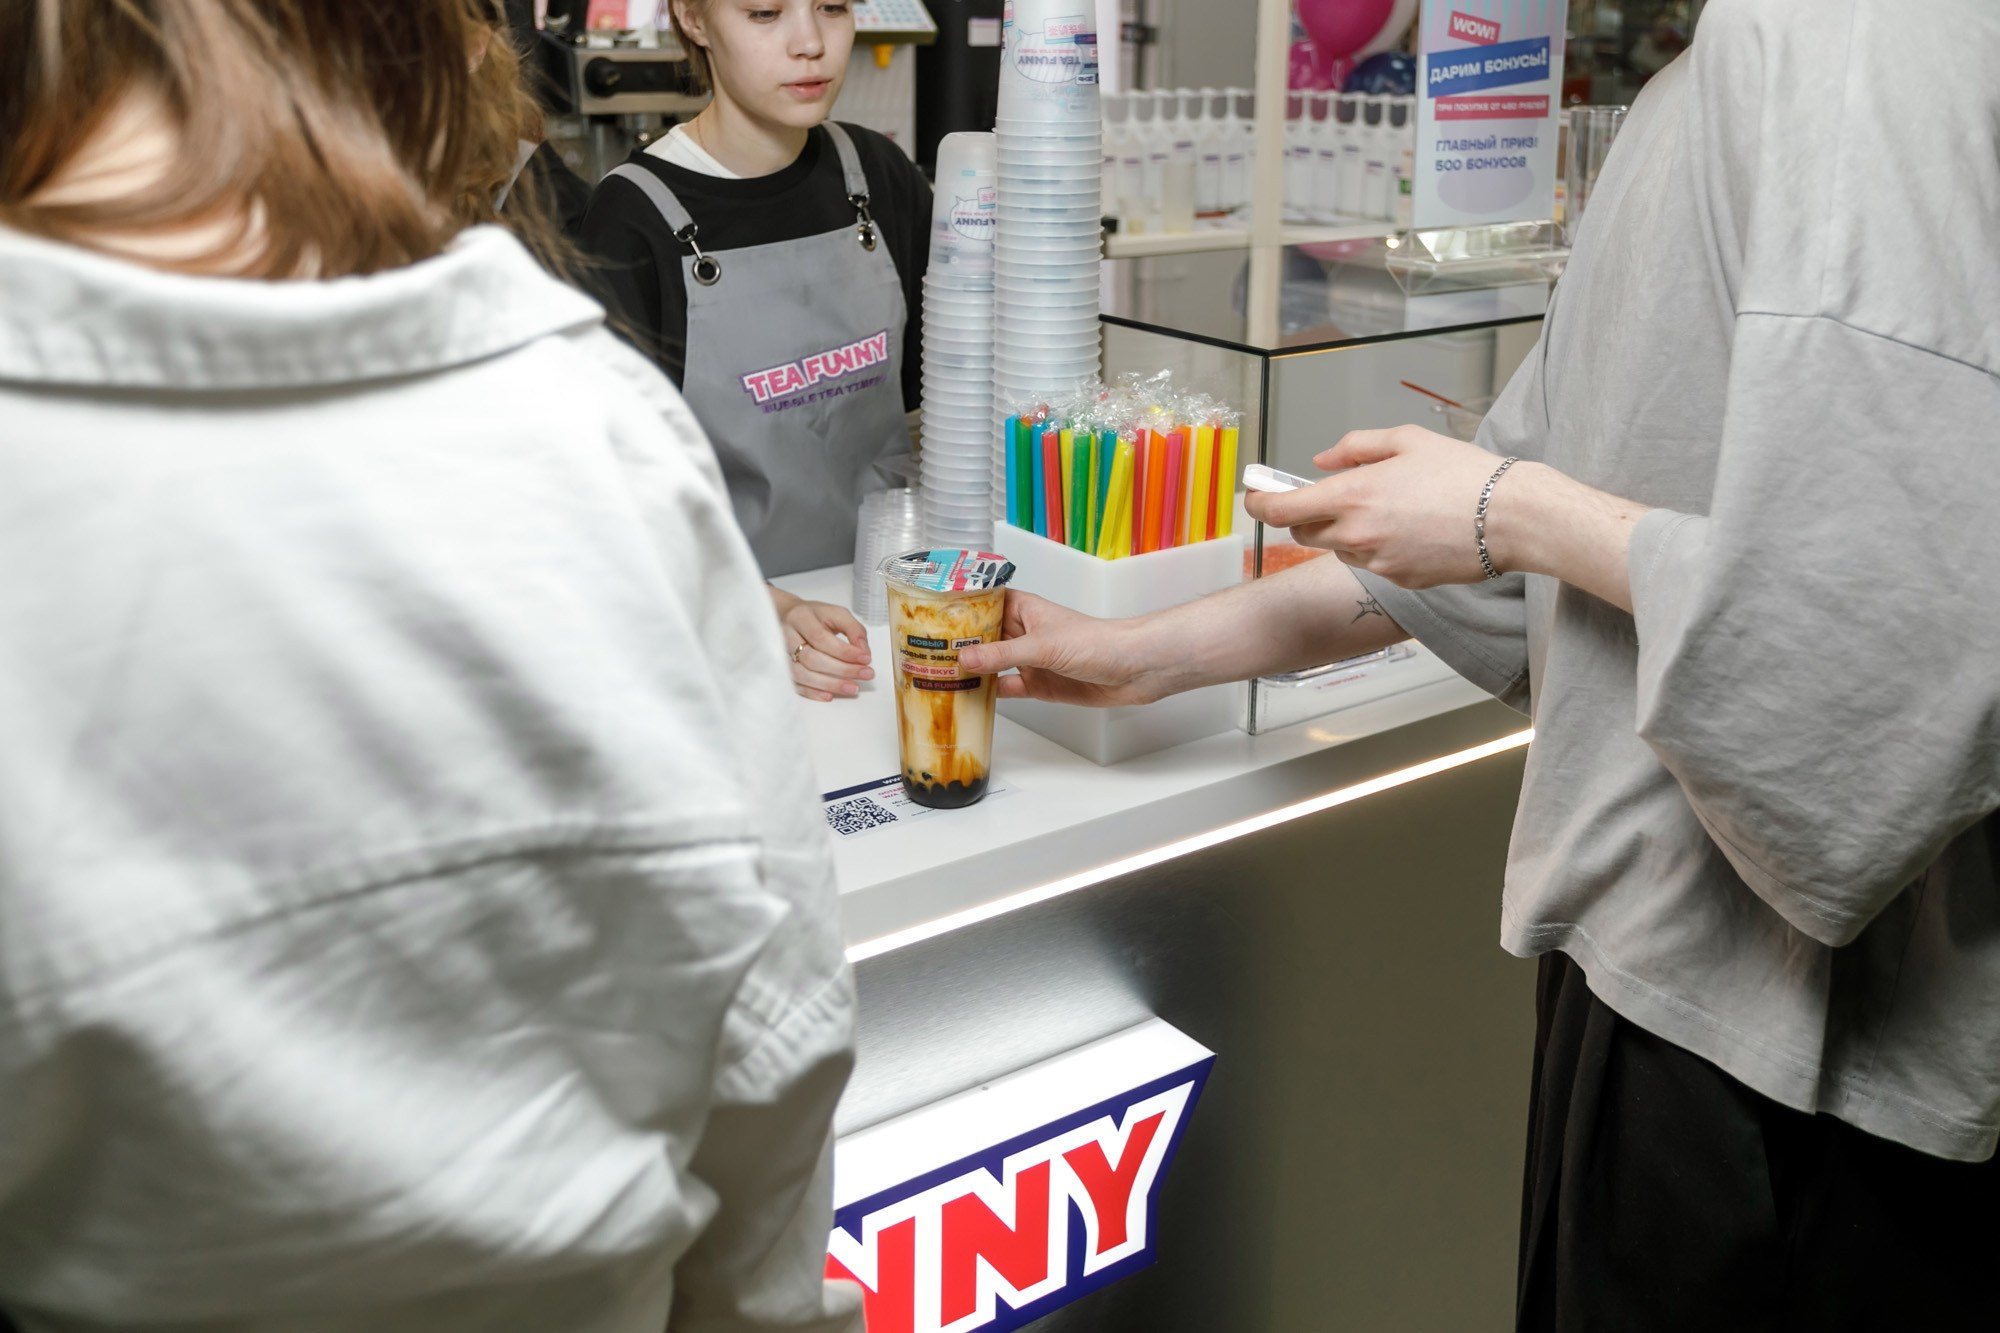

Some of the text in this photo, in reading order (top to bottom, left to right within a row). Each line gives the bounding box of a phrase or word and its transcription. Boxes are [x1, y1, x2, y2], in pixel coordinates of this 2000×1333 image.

[1452, 15, 1496, 41] WOW!
[1430, 47, 1547, 85] ДАРИМ БОНУСЫ!
[1436, 135, 1538, 151] ГЛАВНЫЙ ПРИЗ!
[1435, 156, 1527, 171] 500 БОНУСОВ
[744, 331, 888, 402] TEA FUNNY
[909, 638, 981, 648] НОВЫЙ ДЕНЬ
[900, 648, 958, 662] НОВЫЕ ЭМОЦ
[901, 662, 930, 674] НОВЫЙ
